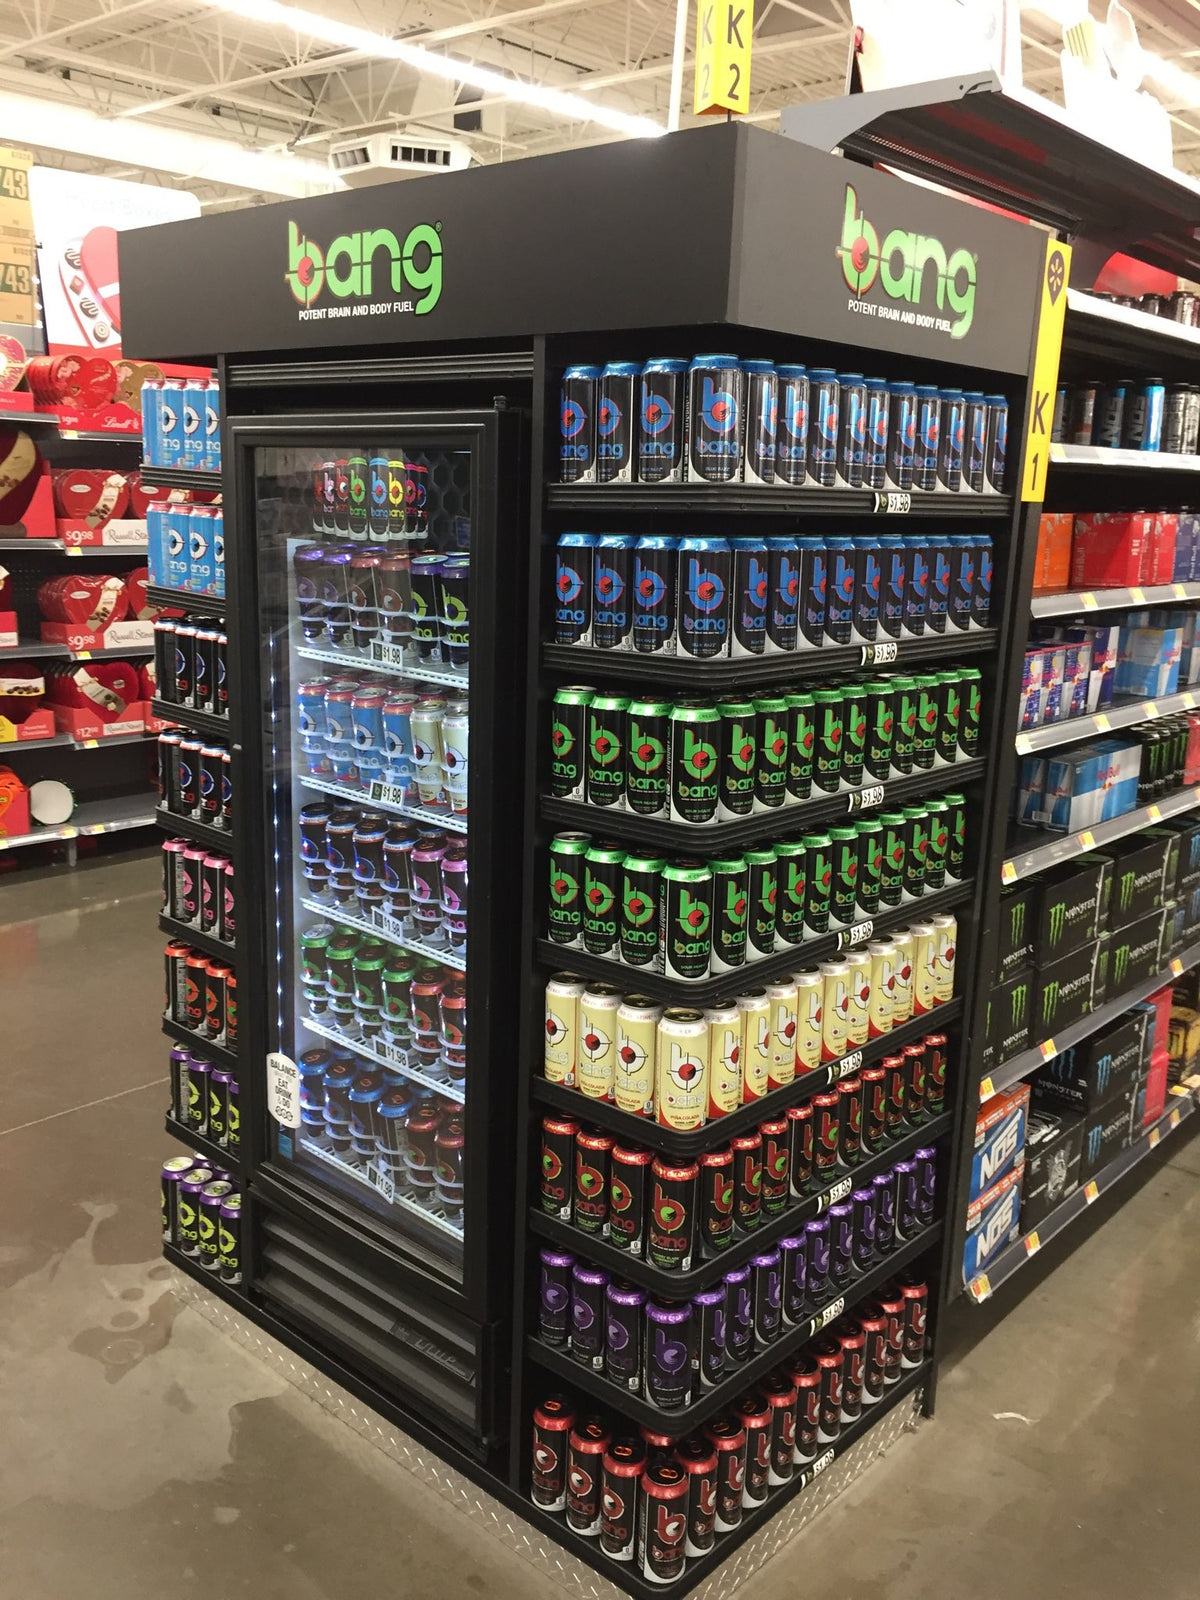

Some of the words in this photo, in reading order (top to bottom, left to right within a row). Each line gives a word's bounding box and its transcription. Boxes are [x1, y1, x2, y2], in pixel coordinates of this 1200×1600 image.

[727, 4, 745, 49] K
[728, 63, 740, 101] 2
[0, 168, 27, 200] 43
[285, 220, 443, 315] bang
[835, 182, 977, 339] bang
[298, 308, 327, 320] POTENT
[328, 306, 351, 319] BRAIN
[352, 304, 368, 316] AND
[370, 302, 392, 315] BODY
[393, 301, 414, 313] FUEL
[848, 299, 878, 316] POTENT
[878, 305, 900, 321] BRAIN
[900, 310, 915, 325] AND
[916, 313, 935, 328] BODY
[935, 318, 952, 333] FUEL
[1032, 390, 1049, 435] K
[561, 443, 589, 461] ang
[599, 443, 624, 460] ang
[1032, 452, 1039, 491] 1
[889, 494, 910, 512] $1.98
[684, 613, 725, 635] bang
[876, 643, 896, 661] $1.98
[552, 762, 577, 779] ang
[382, 787, 402, 804] $1.98
[678, 781, 718, 800] bang
[863, 786, 882, 805] $1.98
[852, 922, 872, 944] $1.98
[387, 1045, 407, 1066] $1.98
[842, 1053, 861, 1072] $1.98
[270, 1059, 297, 1079] BALANCE
[979, 1108, 1024, 1190] NOS
[976, 1185, 1018, 1269] NOS
